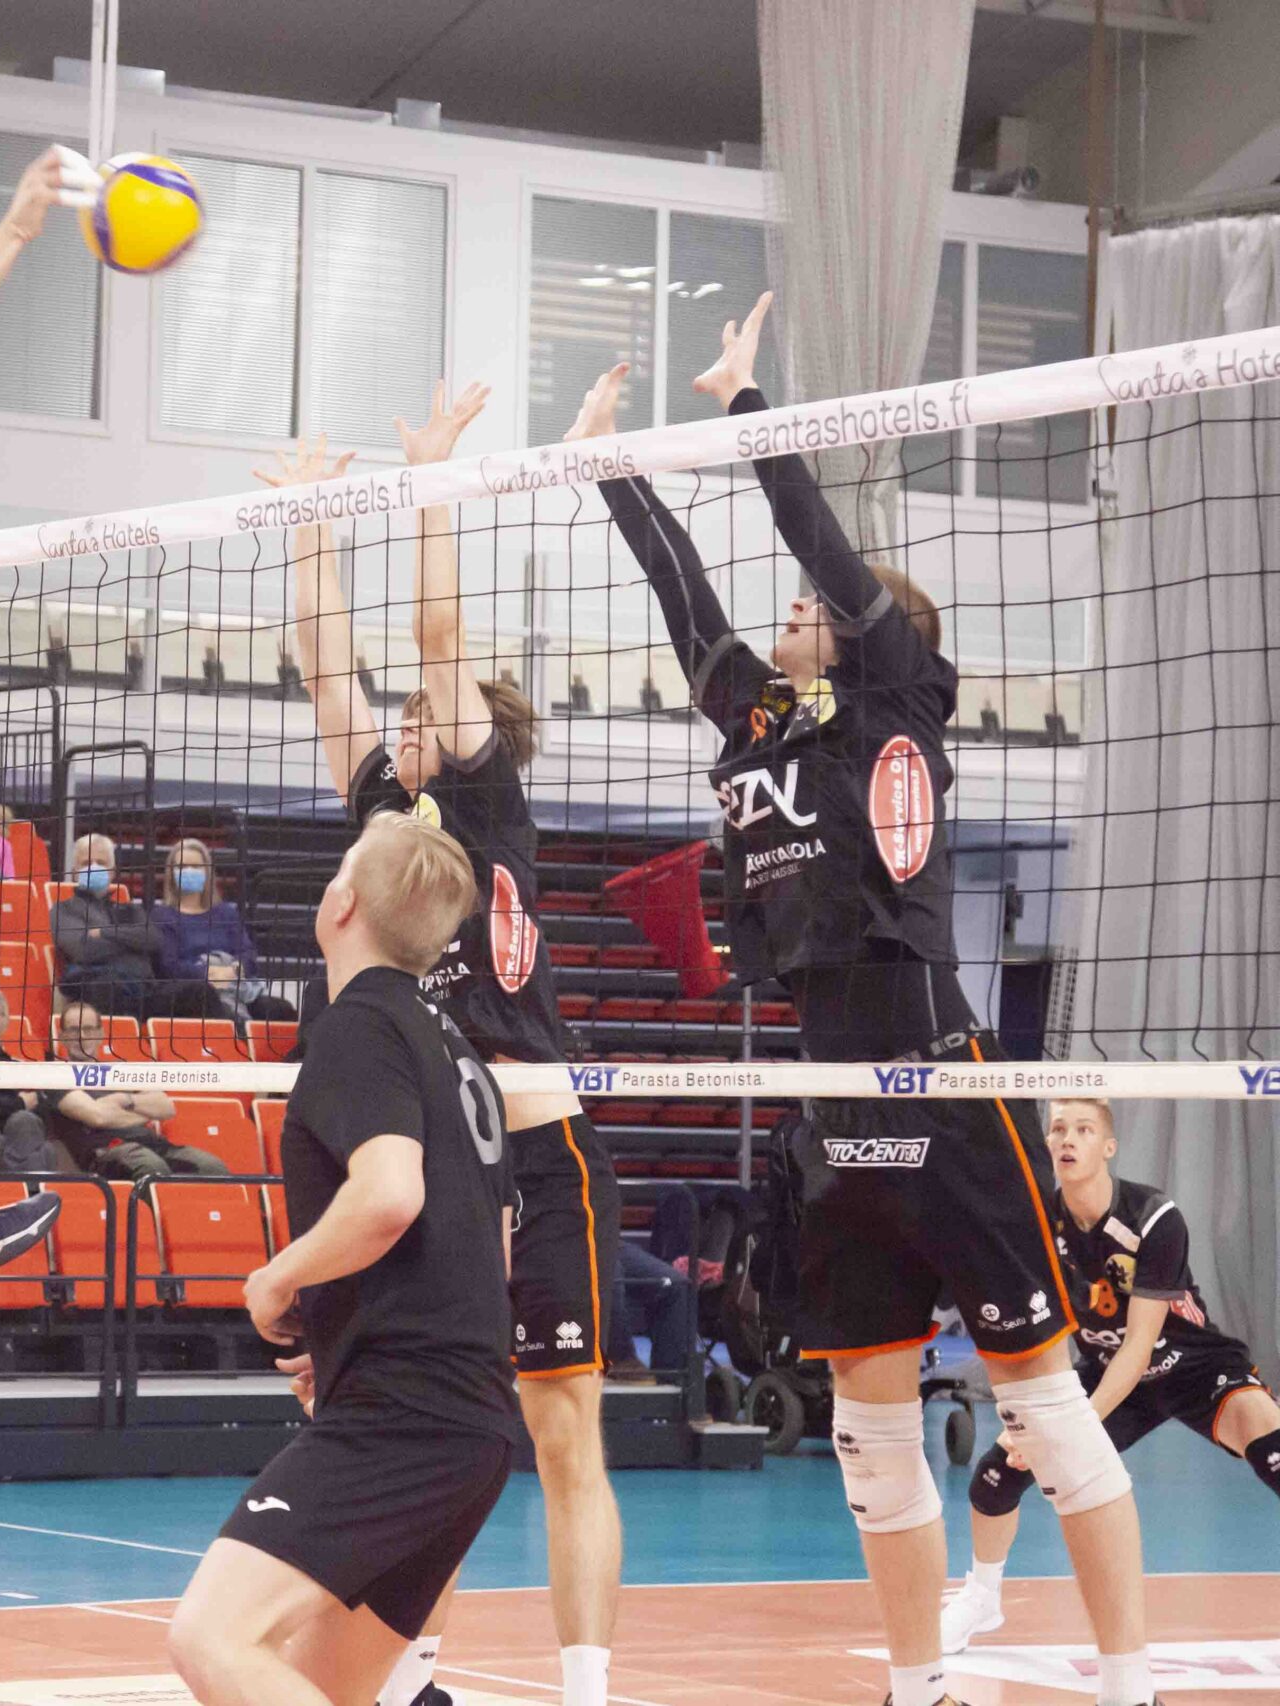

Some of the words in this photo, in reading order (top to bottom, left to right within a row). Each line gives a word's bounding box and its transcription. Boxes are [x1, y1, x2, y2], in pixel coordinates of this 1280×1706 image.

[737, 381, 972, 458] santashotels.fi
[562, 446, 637, 485] Hotels
[236, 470, 415, 531] santashotels.fi
[103, 517, 160, 549] Hotels
[72, 1064, 112, 1087] YBT
[112, 1070, 157, 1083] Parasta
[568, 1066, 620, 1092] YBT
[622, 1071, 680, 1087] Parasta
[873, 1066, 935, 1094] YBT
[939, 1071, 1007, 1089] Parasta
[1238, 1065, 1280, 1095] YB
